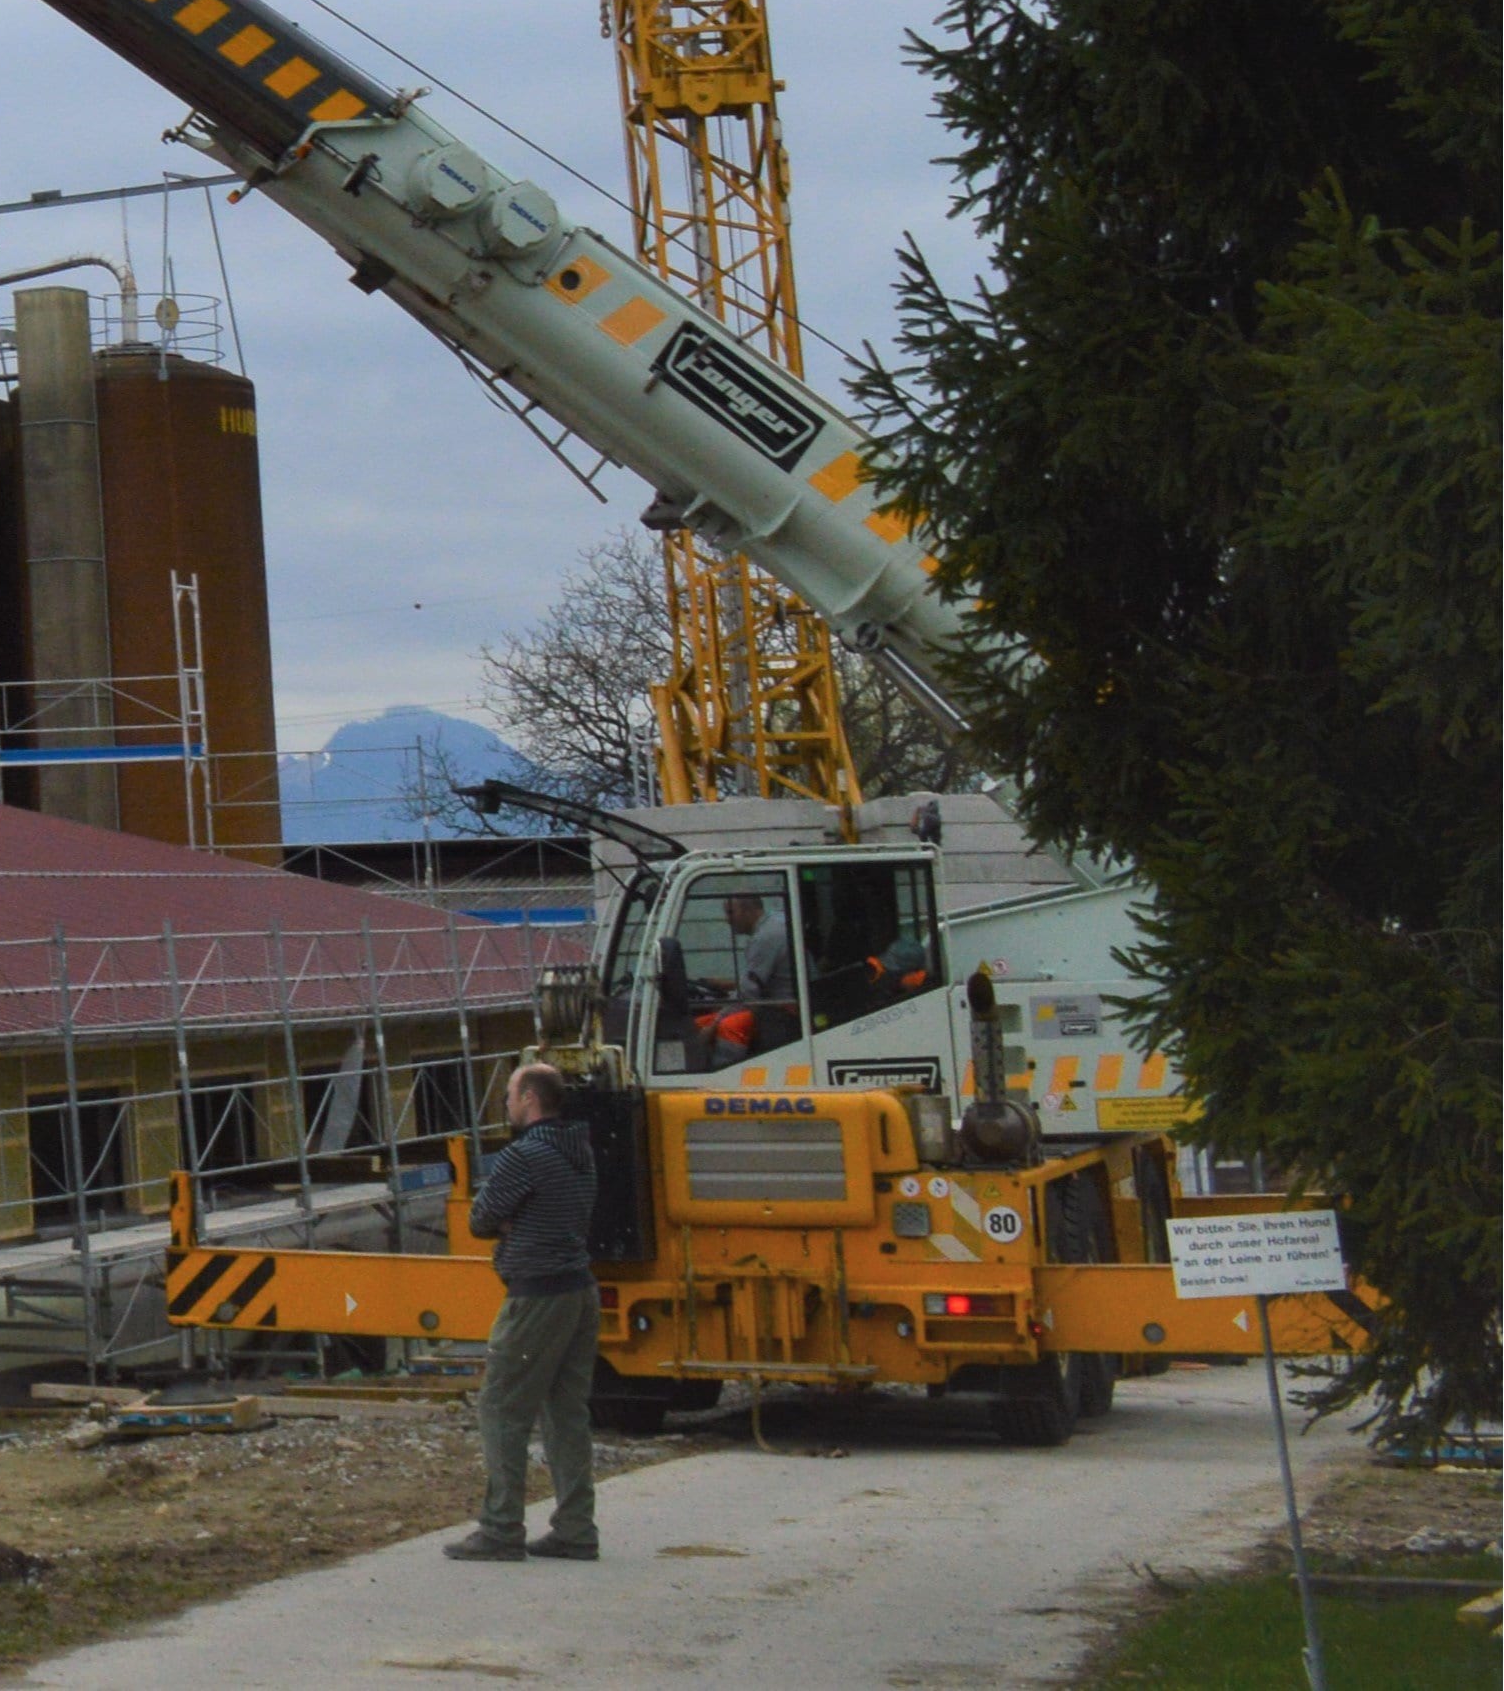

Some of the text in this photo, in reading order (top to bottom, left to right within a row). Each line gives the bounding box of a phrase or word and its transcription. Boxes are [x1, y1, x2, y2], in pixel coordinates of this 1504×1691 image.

[438, 163, 477, 194] DEMAG
[676, 347, 798, 436] Fanger
[704, 1097, 816, 1115] DEMAG
[989, 1213, 1016, 1234] 80
[1173, 1217, 1330, 1236] Wir bitten Sie, Ihren Hund
[1189, 1233, 1320, 1251] durch unser Hofareal
[1184, 1248, 1330, 1268] an der Leine zu führen!
